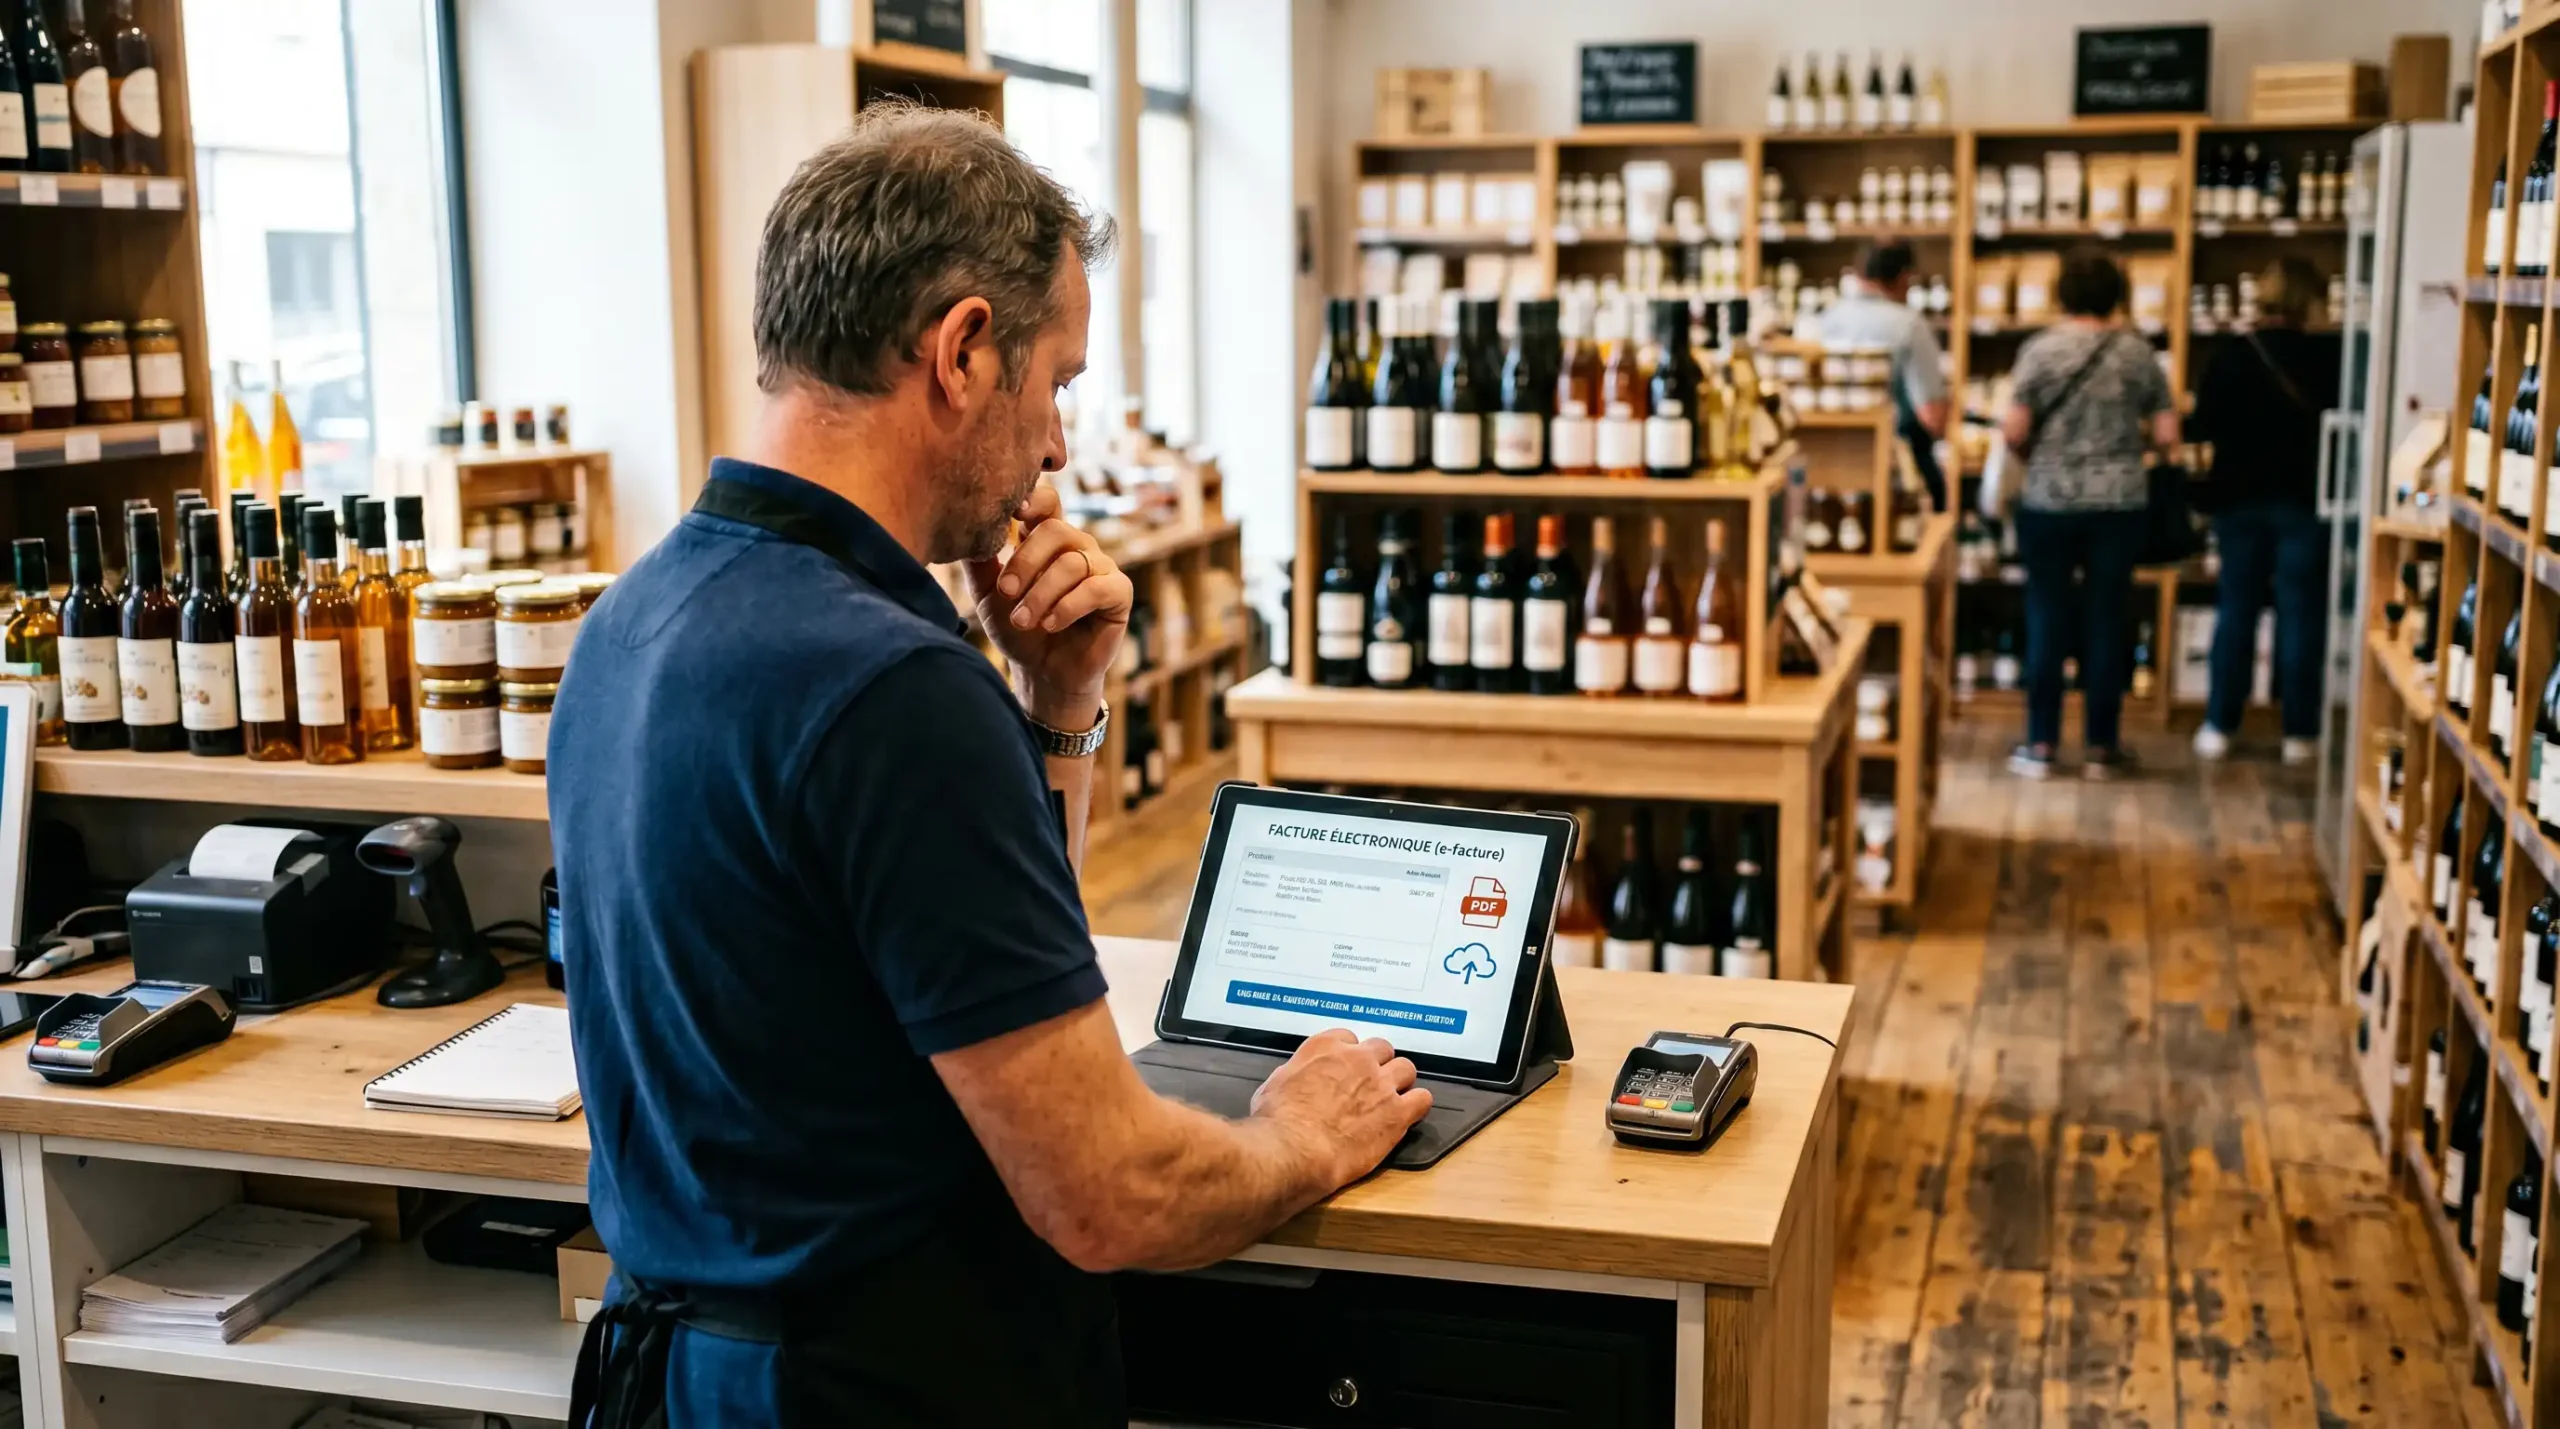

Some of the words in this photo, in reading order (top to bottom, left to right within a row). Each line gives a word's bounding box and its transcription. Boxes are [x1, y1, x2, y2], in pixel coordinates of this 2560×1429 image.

[1268, 824, 1328, 841] FACTURE
[1329, 828, 1432, 853] ÉLECTRONIQUE
[1435, 841, 1505, 863] (e-facture)
[1470, 900, 1498, 913] PDF
